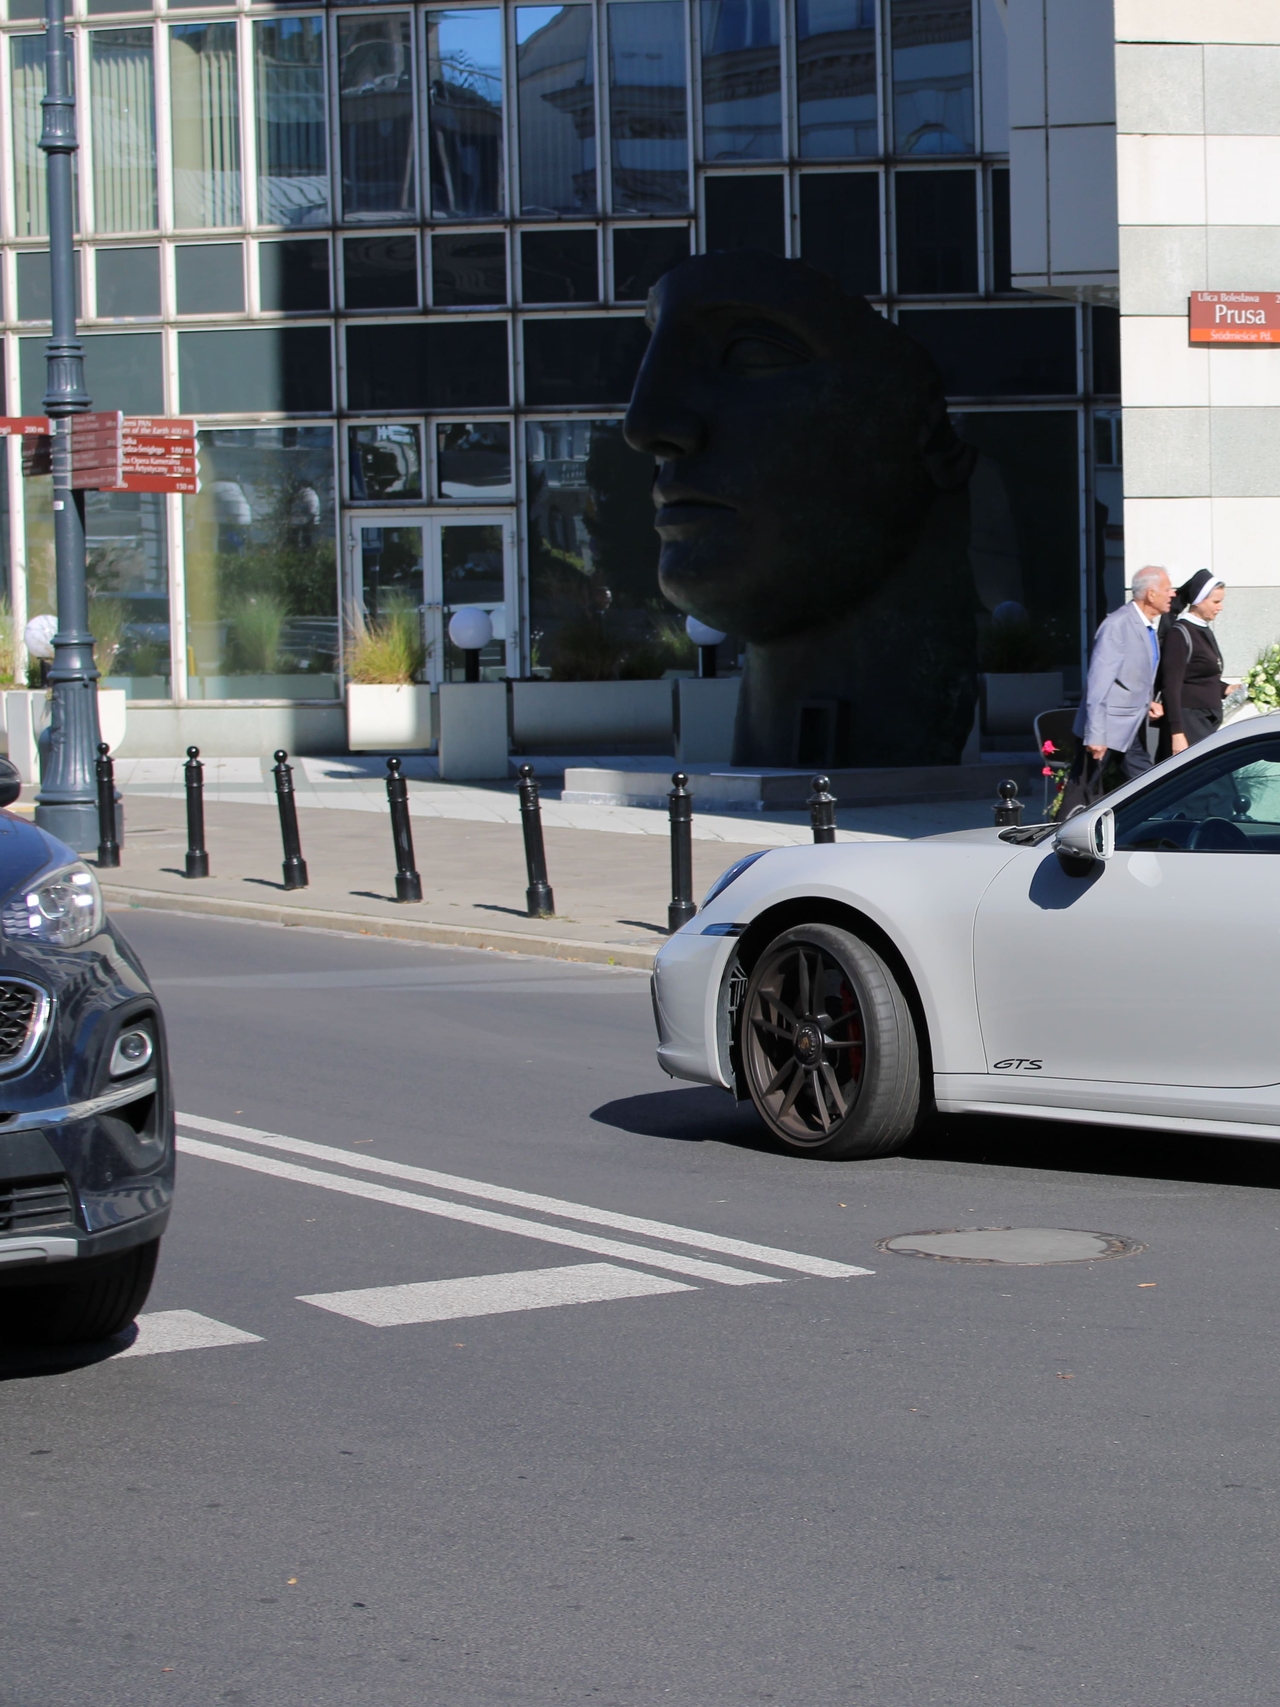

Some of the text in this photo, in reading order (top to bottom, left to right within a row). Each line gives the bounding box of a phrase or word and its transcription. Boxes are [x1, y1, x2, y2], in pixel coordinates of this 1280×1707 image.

[1197, 292, 1218, 302] Ulica
[1215, 304, 1266, 324] Prusa
[993, 1058, 1043, 1070] GTS
